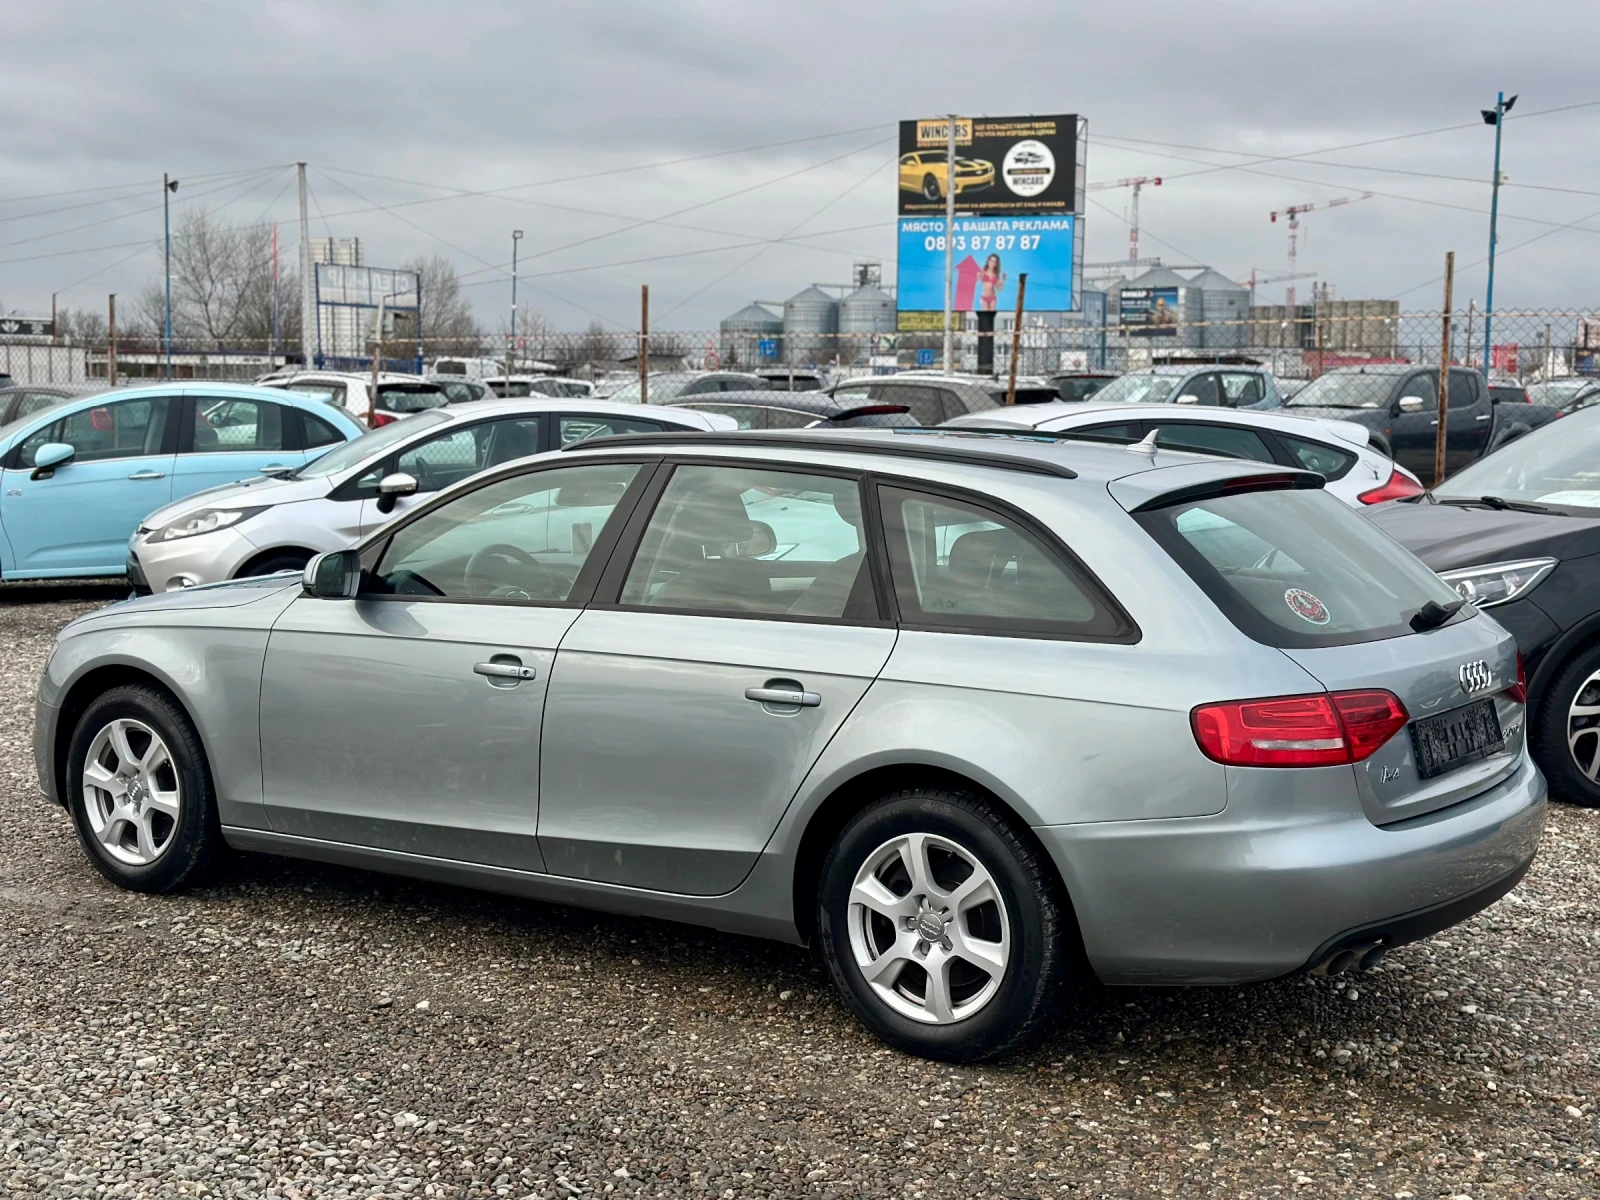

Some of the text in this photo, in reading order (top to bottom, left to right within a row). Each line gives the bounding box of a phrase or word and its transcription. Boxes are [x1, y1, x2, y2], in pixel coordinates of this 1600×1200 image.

[920, 124, 968, 138] WINCRS
[1012, 176, 1044, 186] WINCARS
[902, 222, 944, 232] МЯСТО
[963, 221, 1010, 231] ВАШАТА
[1012, 220, 1069, 230] РЕКЛАМА
[971, 235, 991, 250] 87
[995, 235, 1016, 250] 87
[1020, 234, 1041, 250] 87
